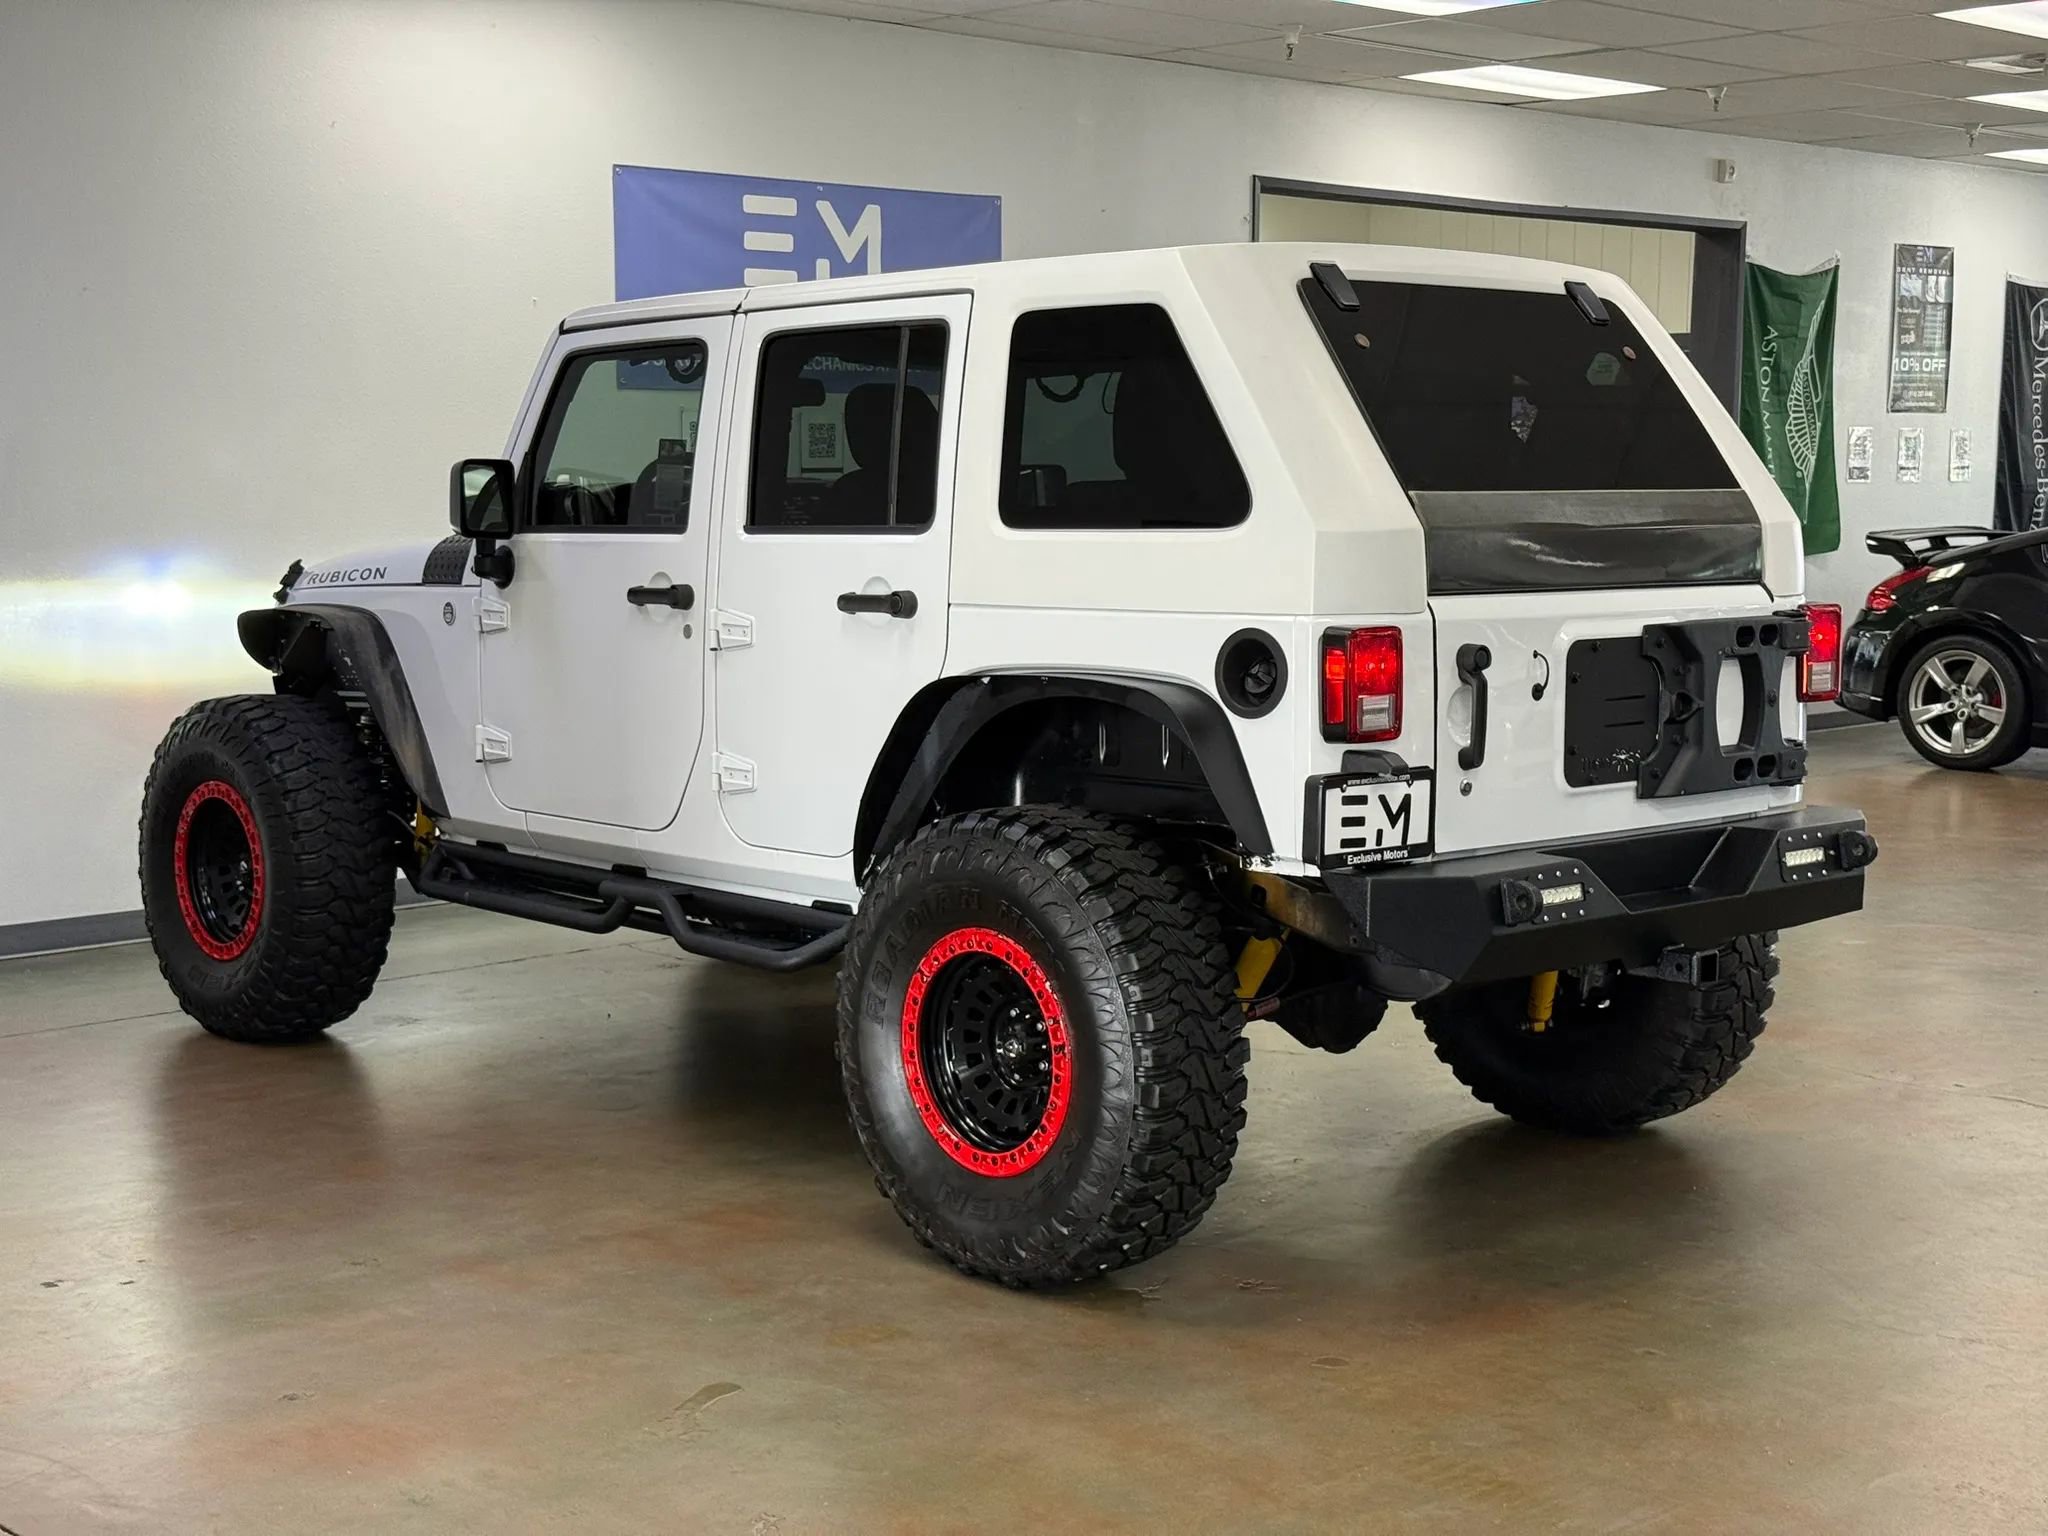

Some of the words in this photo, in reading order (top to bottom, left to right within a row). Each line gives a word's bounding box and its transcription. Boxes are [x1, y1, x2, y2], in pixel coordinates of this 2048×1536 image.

[1919, 267, 1951, 276] REMOVAL
[1759, 324, 1779, 403] ASTON
[1894, 357, 1920, 372] 10%
[1922, 357, 1947, 373] OFF
[1801, 374, 1813, 410] ASTON
[307, 566, 387, 585] RUBICON
[1340, 793, 1412, 849] EM
[1347, 852, 1382, 865] Exclusive
[1383, 849, 1409, 861] Motors
